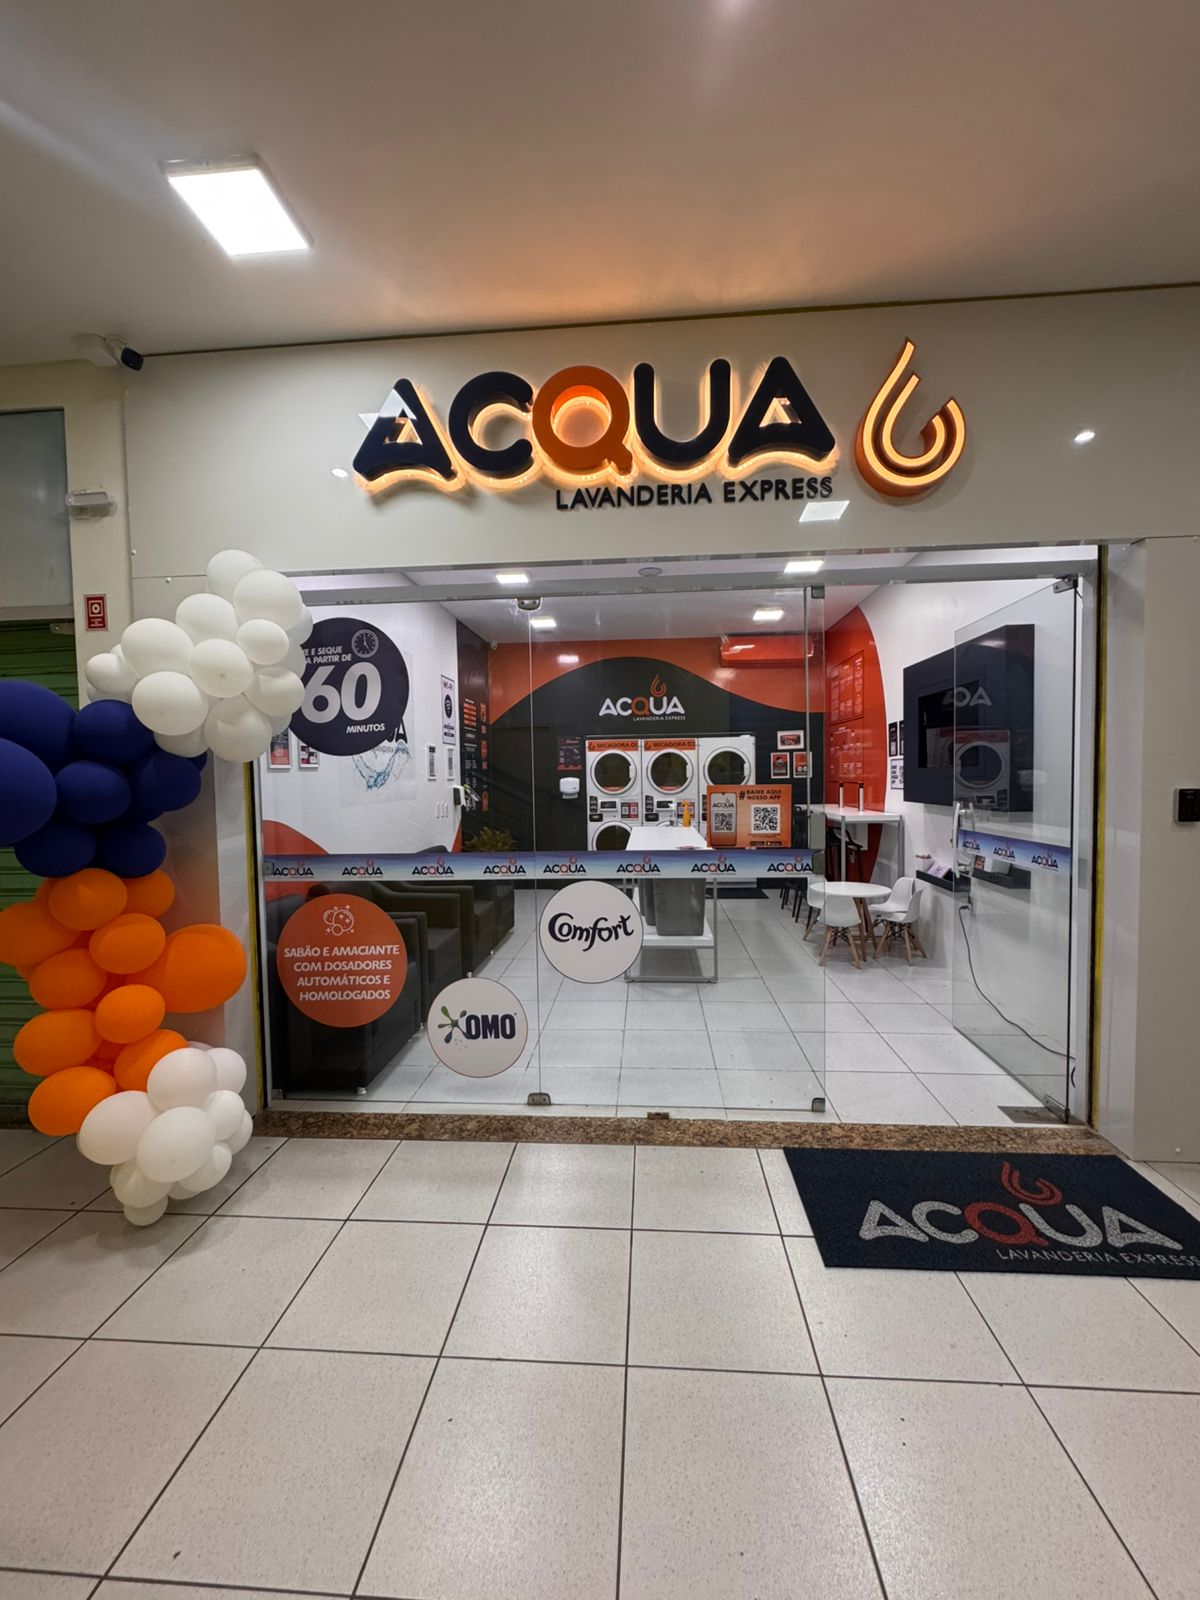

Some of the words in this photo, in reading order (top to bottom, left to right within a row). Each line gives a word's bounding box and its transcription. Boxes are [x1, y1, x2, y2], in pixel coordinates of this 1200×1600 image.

[352, 356, 836, 481] ACQUA
[556, 481, 713, 511] LAVANDERIA
[723, 476, 834, 502] EXPRESS
[311, 648, 317, 656] E
[317, 645, 343, 655] SEQUE
[313, 654, 340, 664] PARTIR
[341, 653, 352, 662] DE
[300, 661, 382, 724] 60
[598, 695, 686, 717] ACQUA
[346, 723, 386, 734] MINUTOS
[273, 866, 314, 876] ACQUA
[342, 866, 383, 876] ACQUA
[411, 866, 454, 876] ACQUA
[483, 865, 526, 875] ACQUA
[543, 863, 587, 873] ACQUA
[616, 863, 661, 873] ACQUA
[691, 862, 736, 872] ACQUA
[767, 862, 812, 872] ACQUA
[548, 912, 634, 952] Comfort
[284, 945, 320, 958] SABÃO
[322, 947, 330, 956] E
[332, 945, 400, 956] AMACIANTE
[294, 962, 322, 971] COM
[325, 960, 392, 971] DOSADORES
[297, 974, 381, 986] AUTOMÁTICOS
[383, 975, 391, 984] E
[300, 989, 391, 1001] HOMOLOGADOS
[465, 1013, 516, 1040] OMO
[858, 1200, 1184, 1251] ACQUA
[996, 1248, 1119, 1263] LAVANDERIA
[1120, 1252, 1200, 1267] EXPRESS
